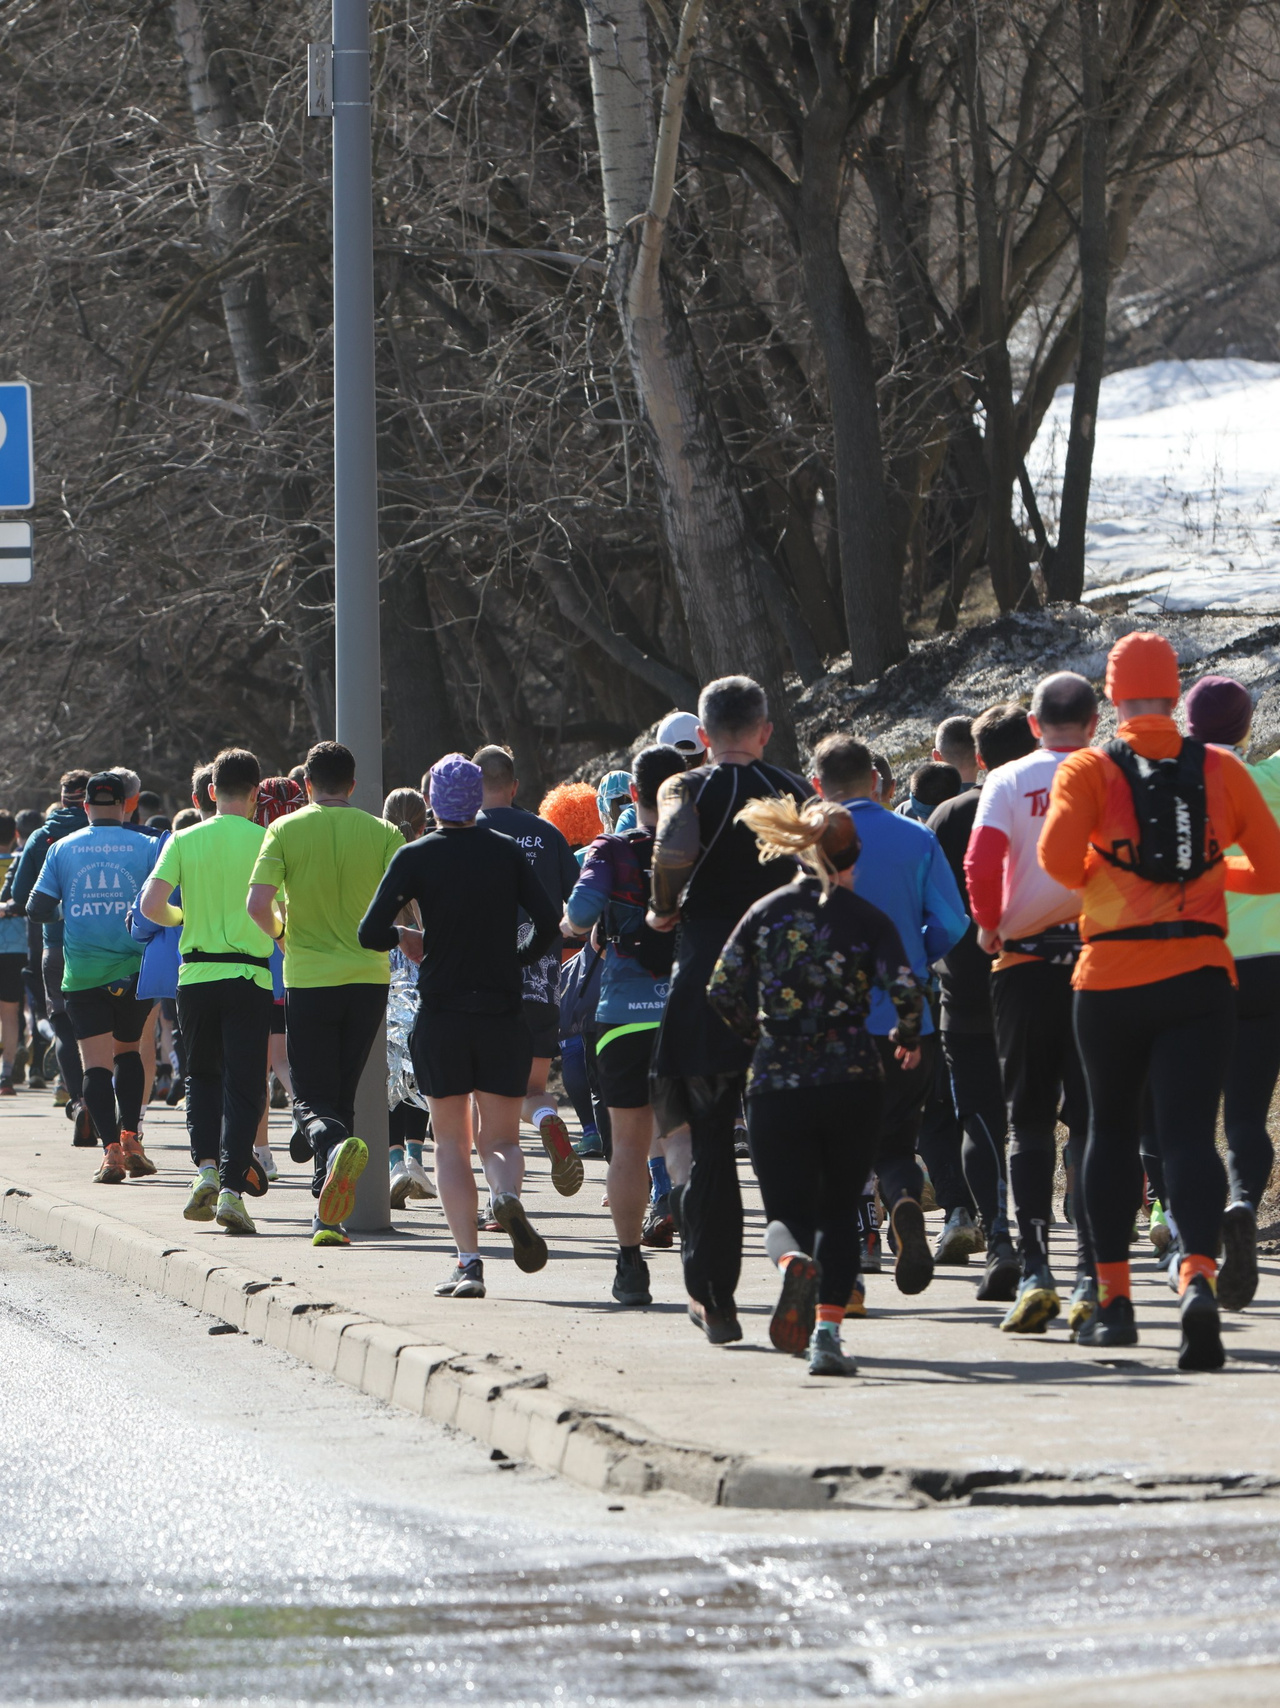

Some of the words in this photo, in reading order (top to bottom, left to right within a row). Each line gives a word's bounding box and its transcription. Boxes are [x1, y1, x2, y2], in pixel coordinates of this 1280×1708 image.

[70, 843, 134, 855] Тимофеев
[70, 878, 79, 897] КЛУБ
[77, 861, 120, 878] ЛЮБИТЕЛЕЙ
[120, 867, 138, 894] СПОРТА
[82, 891, 124, 899] РАМЕНСКОЕ
